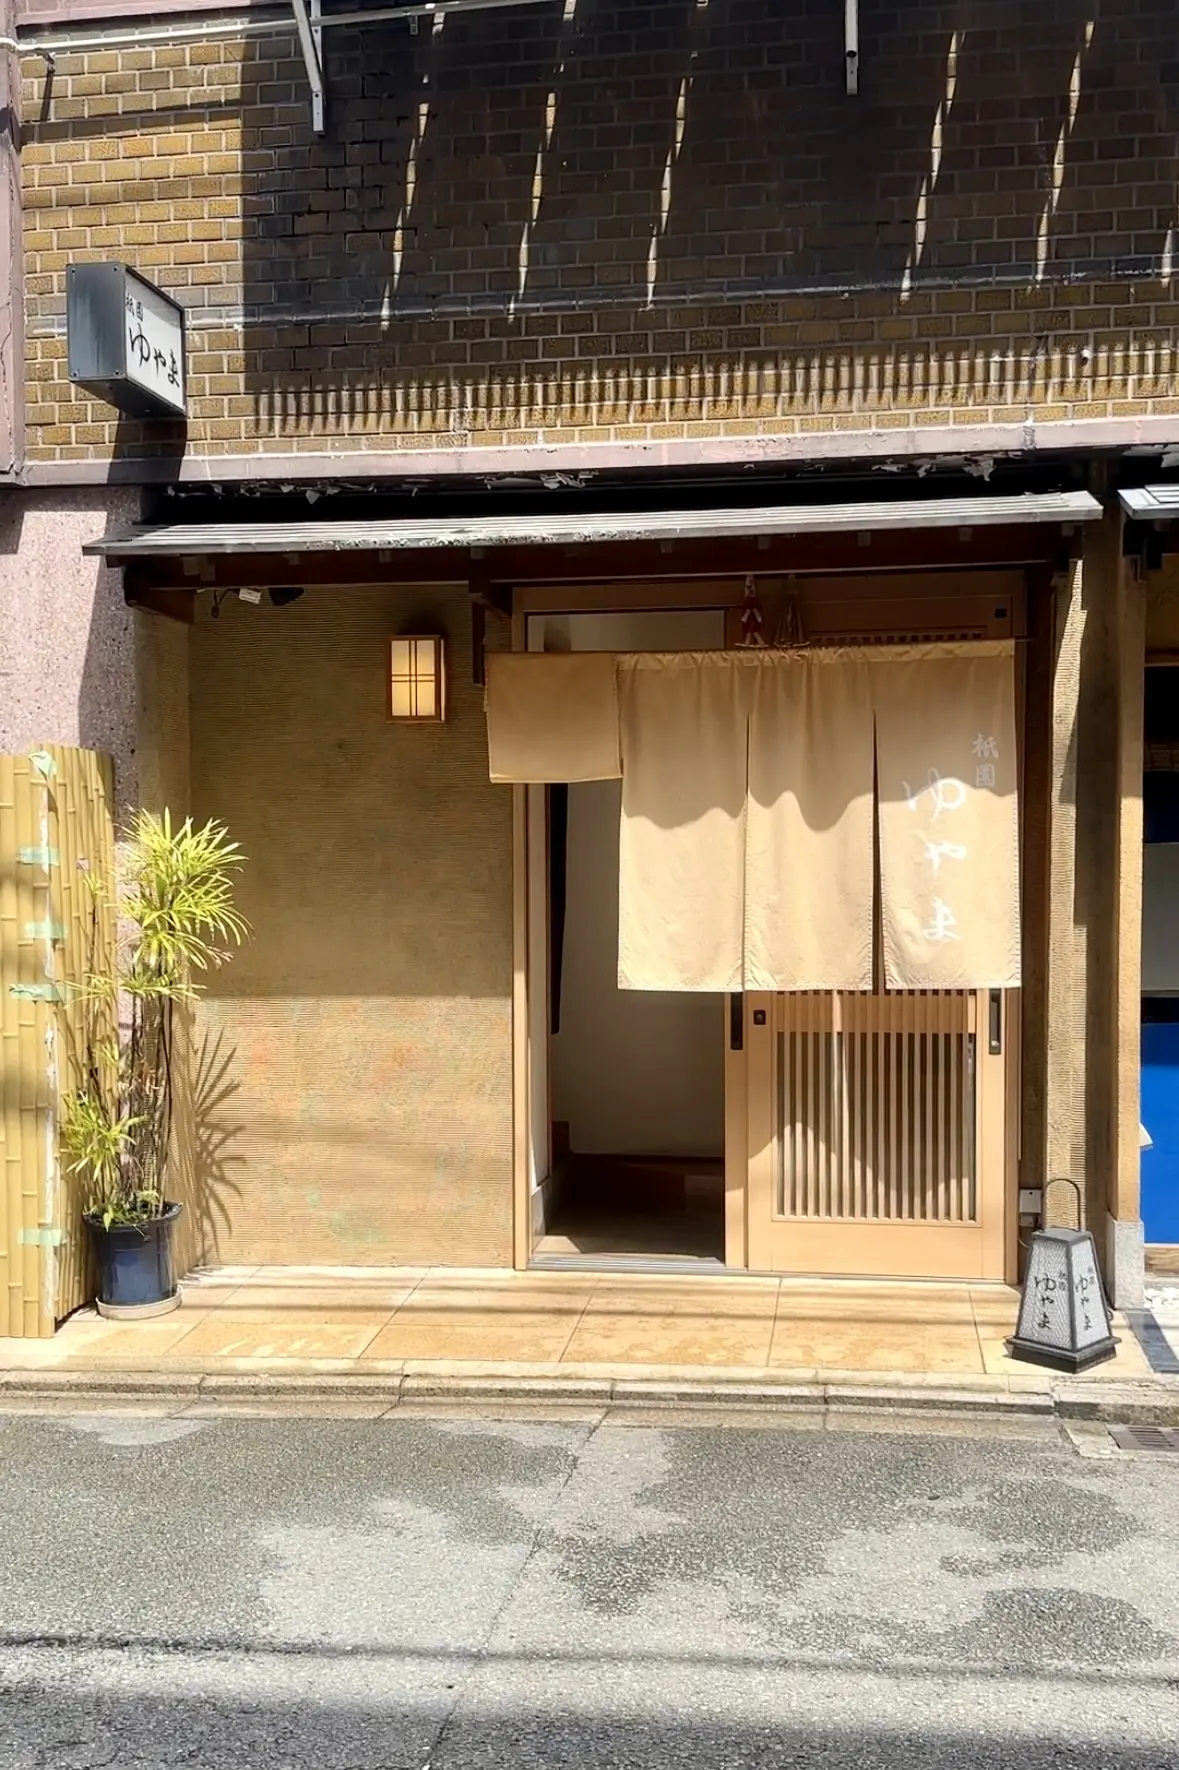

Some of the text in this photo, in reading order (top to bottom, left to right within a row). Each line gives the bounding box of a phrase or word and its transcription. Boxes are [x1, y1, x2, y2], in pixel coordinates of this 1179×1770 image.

[128, 322, 180, 388] ゆやま
[900, 767, 967, 941] ゆやま
[1034, 1272, 1057, 1330] ゆやま
[1074, 1275, 1092, 1331] ゆやま
